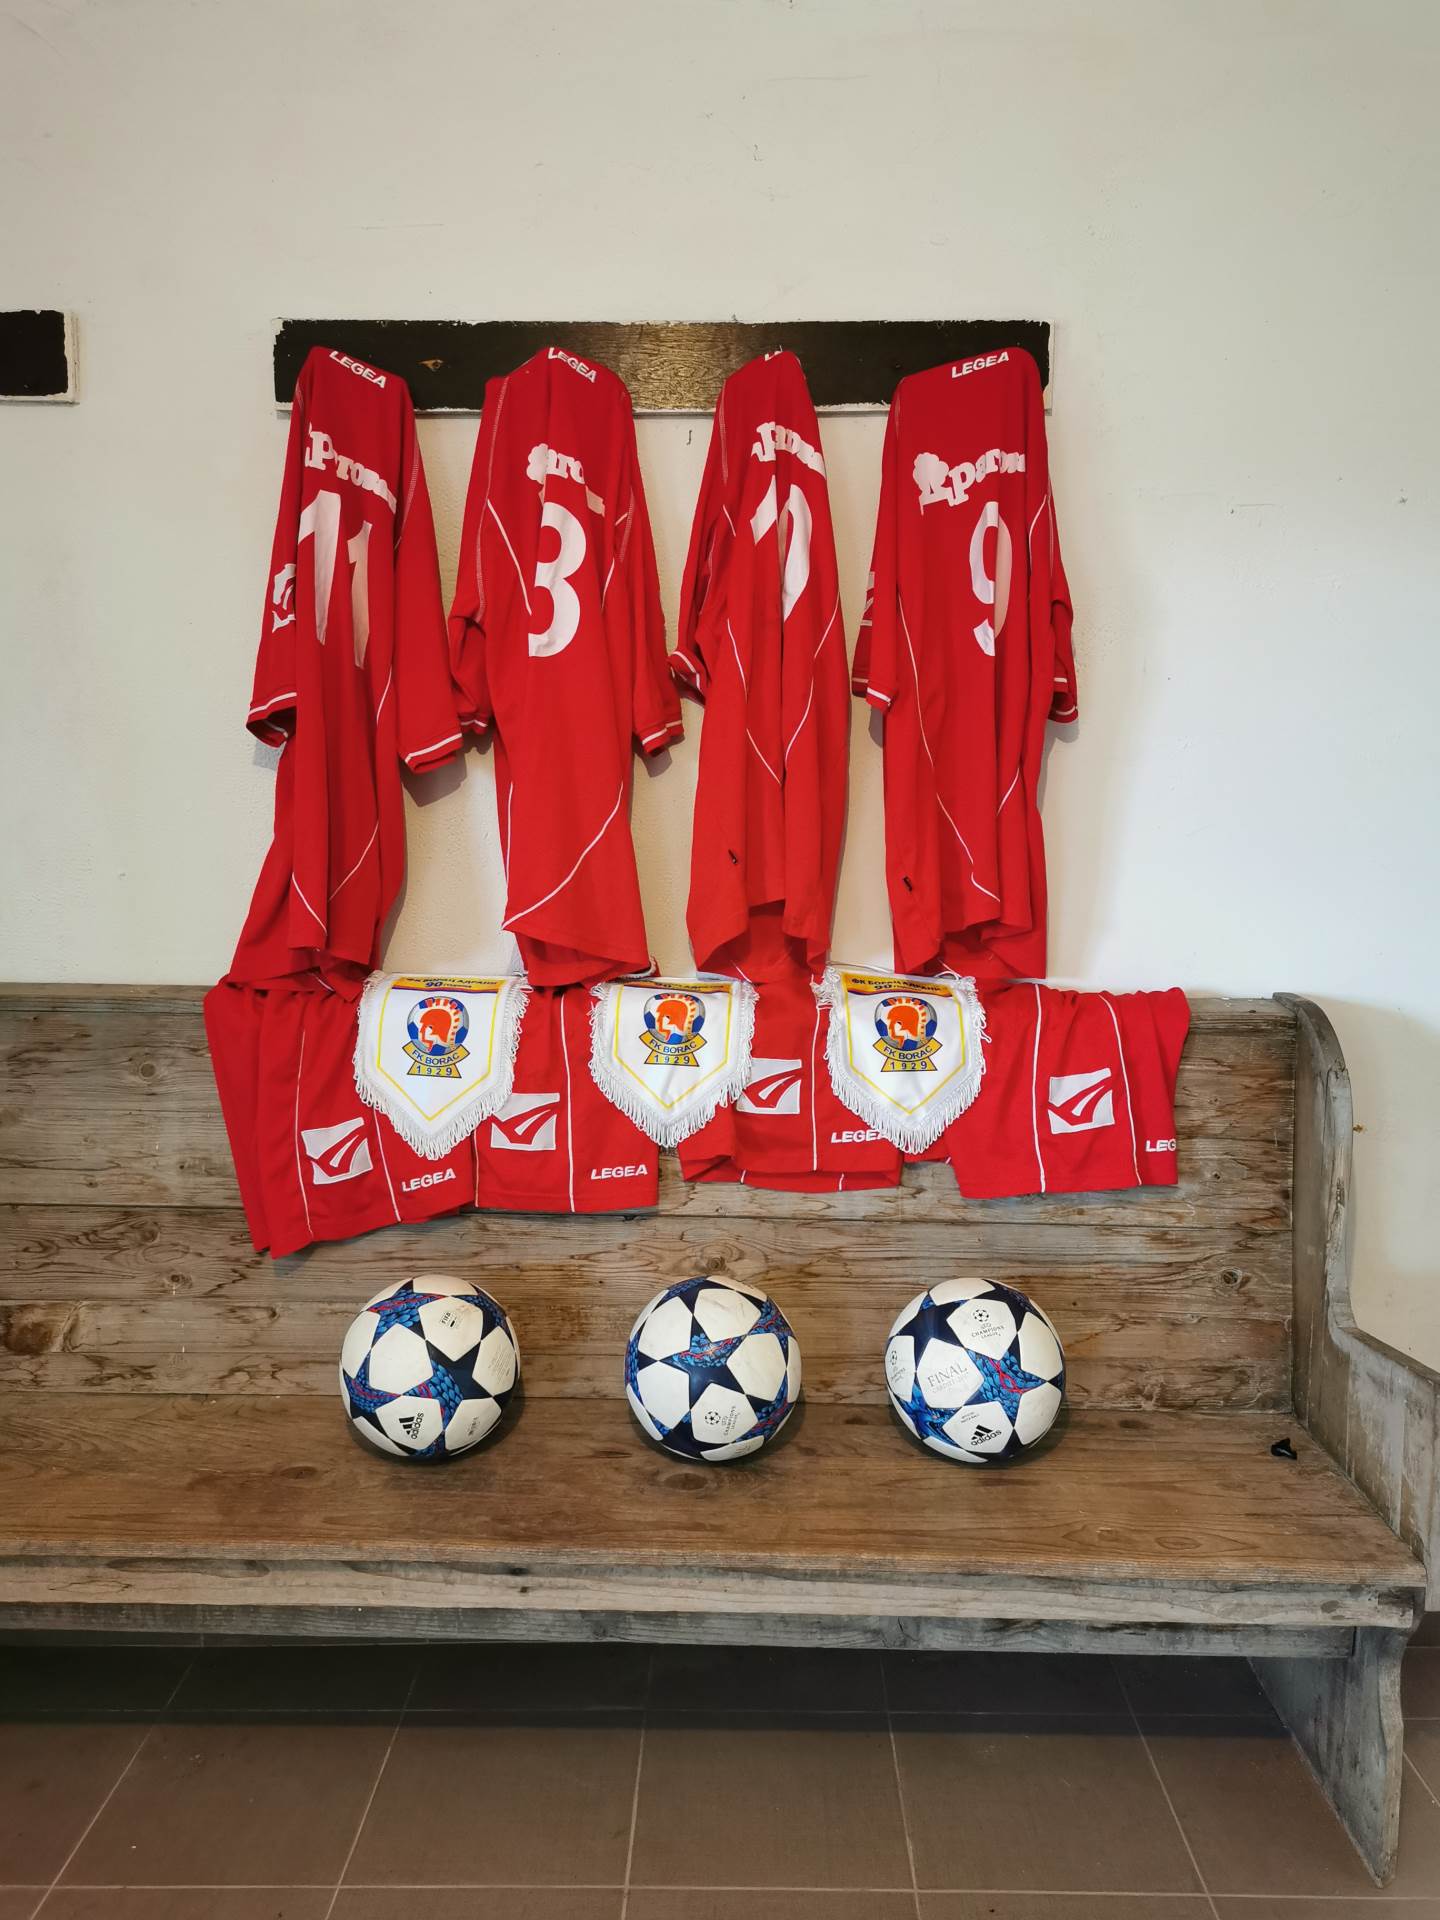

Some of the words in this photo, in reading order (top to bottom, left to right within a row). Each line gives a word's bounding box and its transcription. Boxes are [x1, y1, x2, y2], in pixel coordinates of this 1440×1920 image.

[329, 350, 387, 389] LEGEA
[548, 347, 596, 383] LEGEA
[951, 351, 1009, 379] LEGEA
[298, 490, 372, 669] 11
[528, 502, 586, 657] 3
[969, 501, 1012, 656] 9
[411, 1050, 423, 1062] FK
[426, 1052, 461, 1065] BORAC
[650, 1039, 661, 1050] FK
[663, 1042, 697, 1054] BORAC
[883, 1046, 897, 1057] FK
[898, 1045, 933, 1060] BORAC
[416, 1065, 453, 1076] 1929
[654, 1055, 690, 1065] 1929
[890, 1061, 927, 1070] 1929
[402, 1167, 457, 1193] LEGEA
[591, 1164, 648, 1181] LEGEA
[927, 1363, 968, 1387] FINAL
[411, 1412, 425, 1440] adidas
[970, 1430, 1002, 1446] adidas
